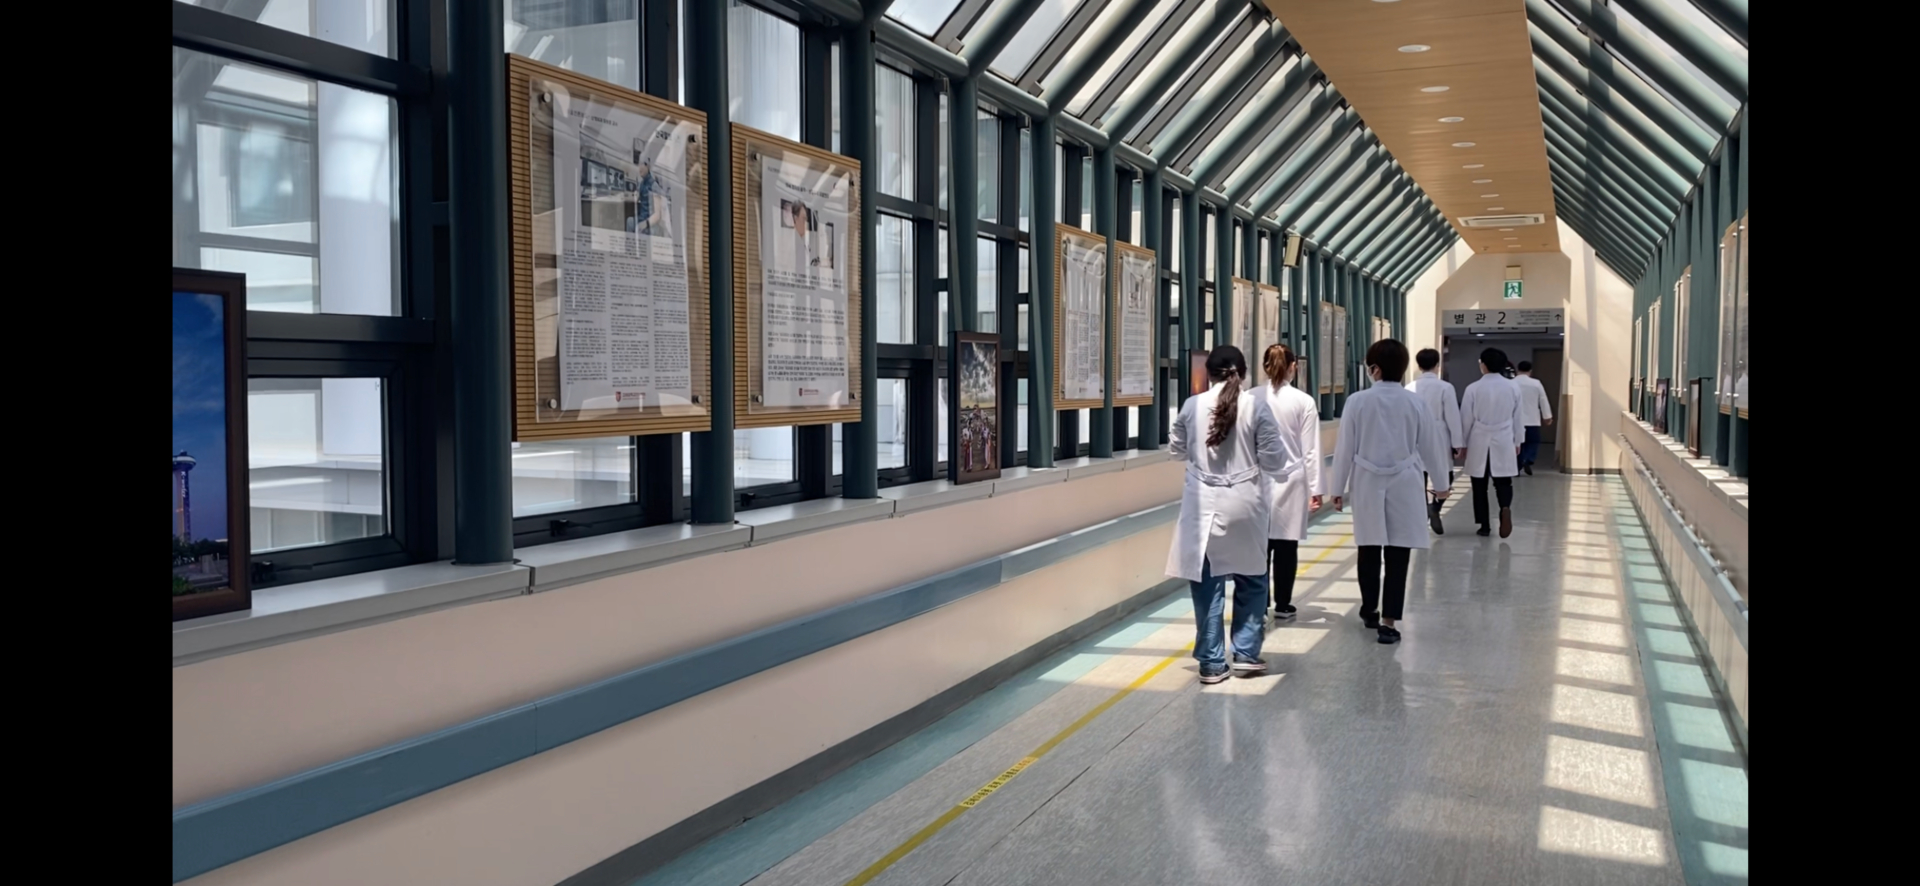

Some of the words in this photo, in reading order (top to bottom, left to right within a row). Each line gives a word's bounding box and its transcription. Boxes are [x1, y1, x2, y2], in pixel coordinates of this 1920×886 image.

[1454, 313, 1464, 325] 별
[1475, 313, 1487, 325] 관
[1497, 311, 1506, 325] 2
